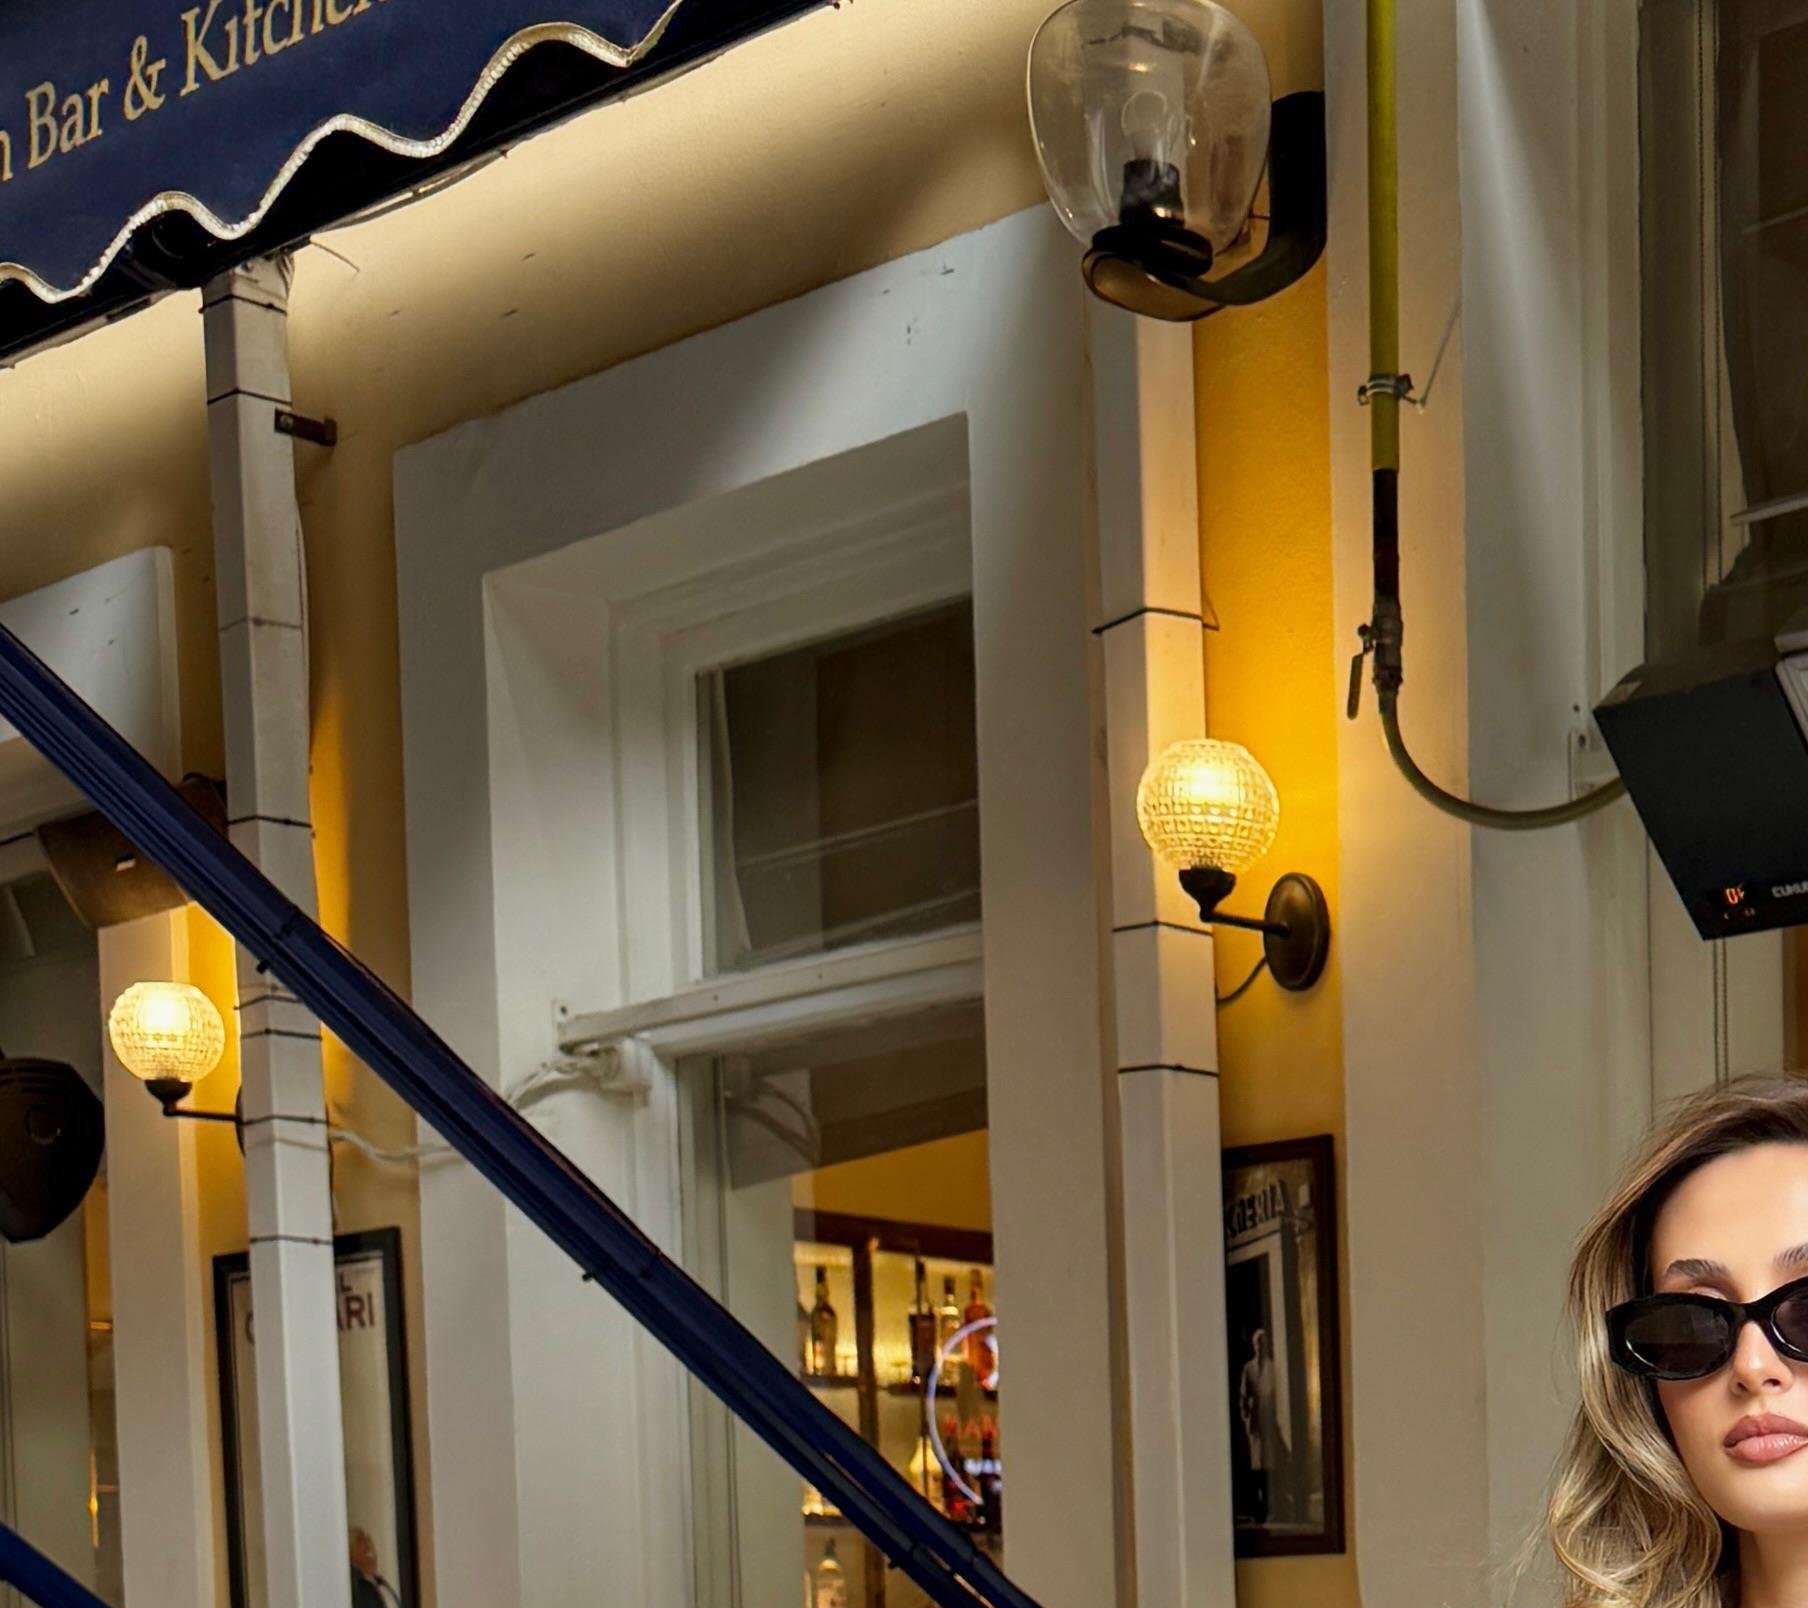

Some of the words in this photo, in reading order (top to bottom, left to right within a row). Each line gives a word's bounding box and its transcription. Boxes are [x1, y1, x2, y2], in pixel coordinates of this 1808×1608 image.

[25, 79, 110, 170] Bar
[123, 34, 167, 121] &
[179, 0, 385, 97] Kitc
